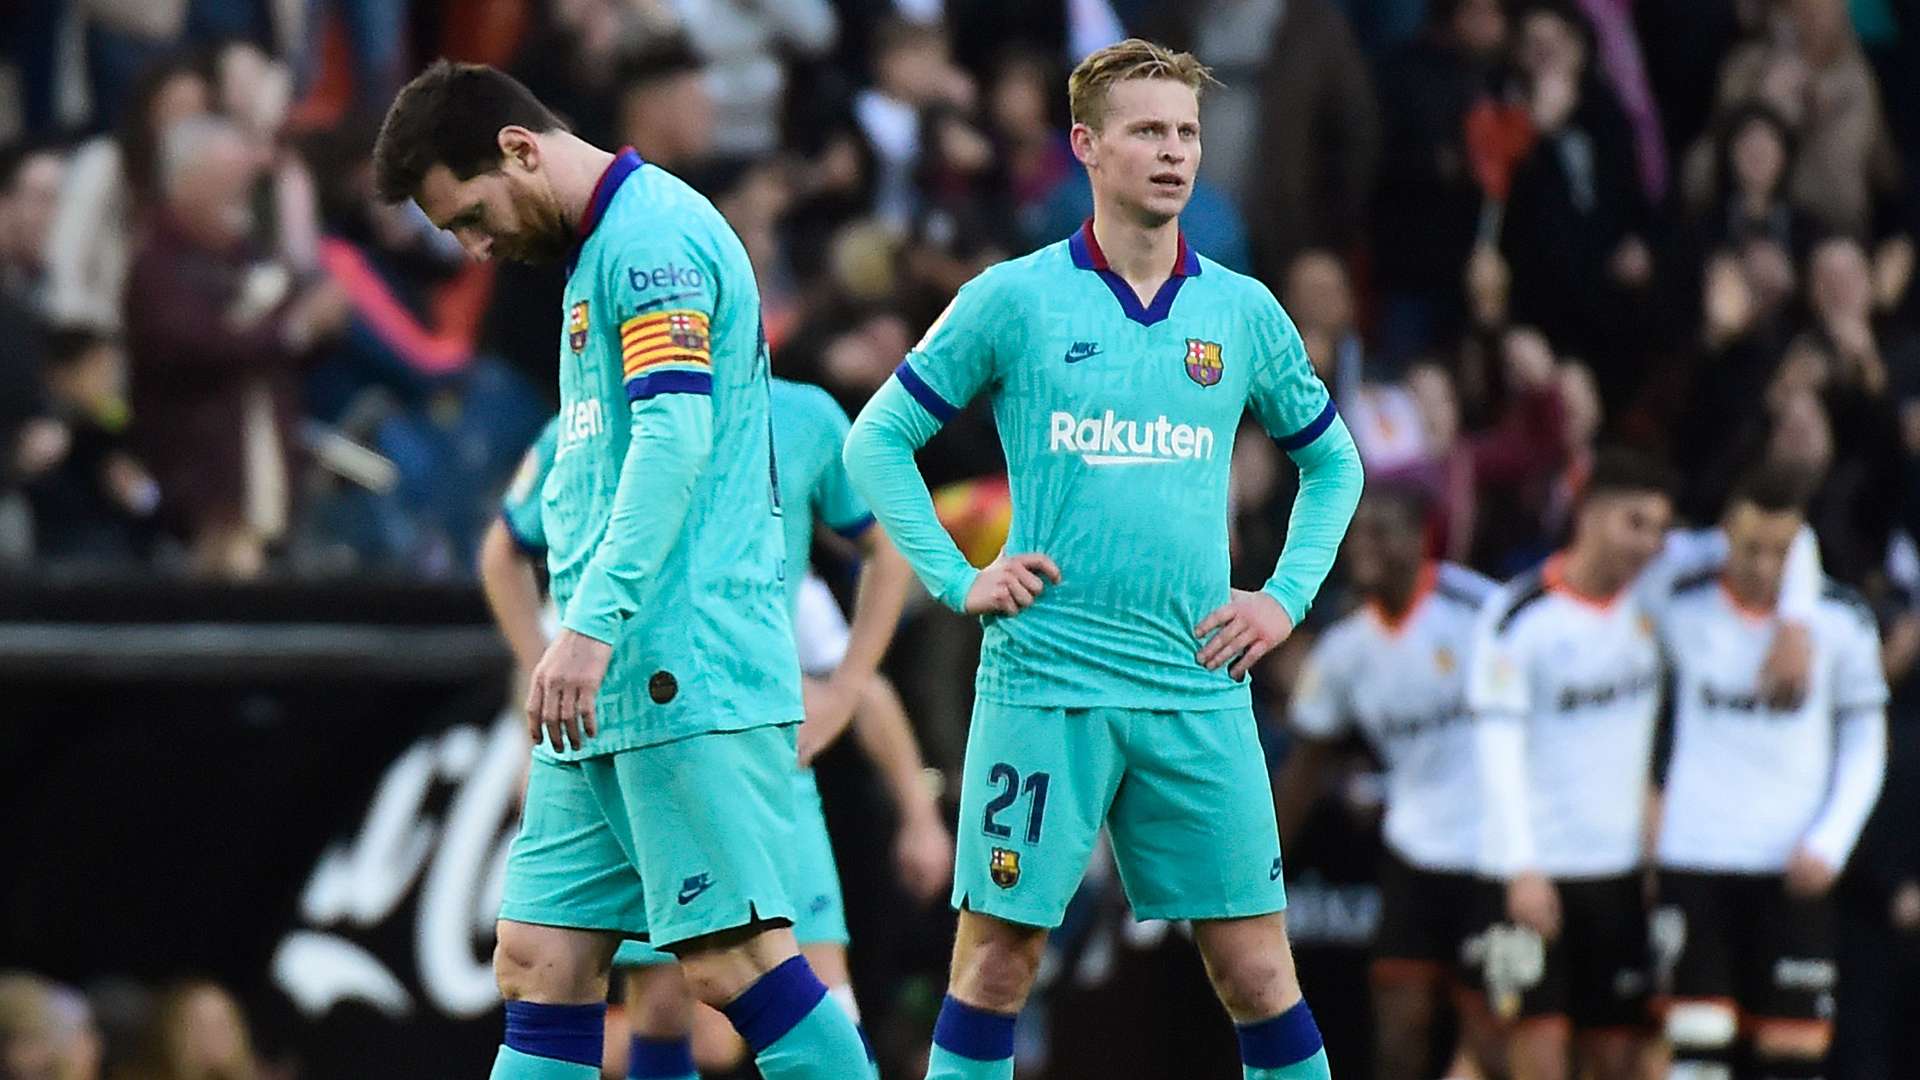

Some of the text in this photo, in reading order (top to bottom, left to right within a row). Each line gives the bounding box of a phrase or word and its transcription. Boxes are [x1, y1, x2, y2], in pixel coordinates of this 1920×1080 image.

[628, 262, 701, 292] beko
[1071, 341, 1099, 354] NIKE
[1051, 410, 1214, 459] Rakuten
[982, 762, 1050, 846] 21
